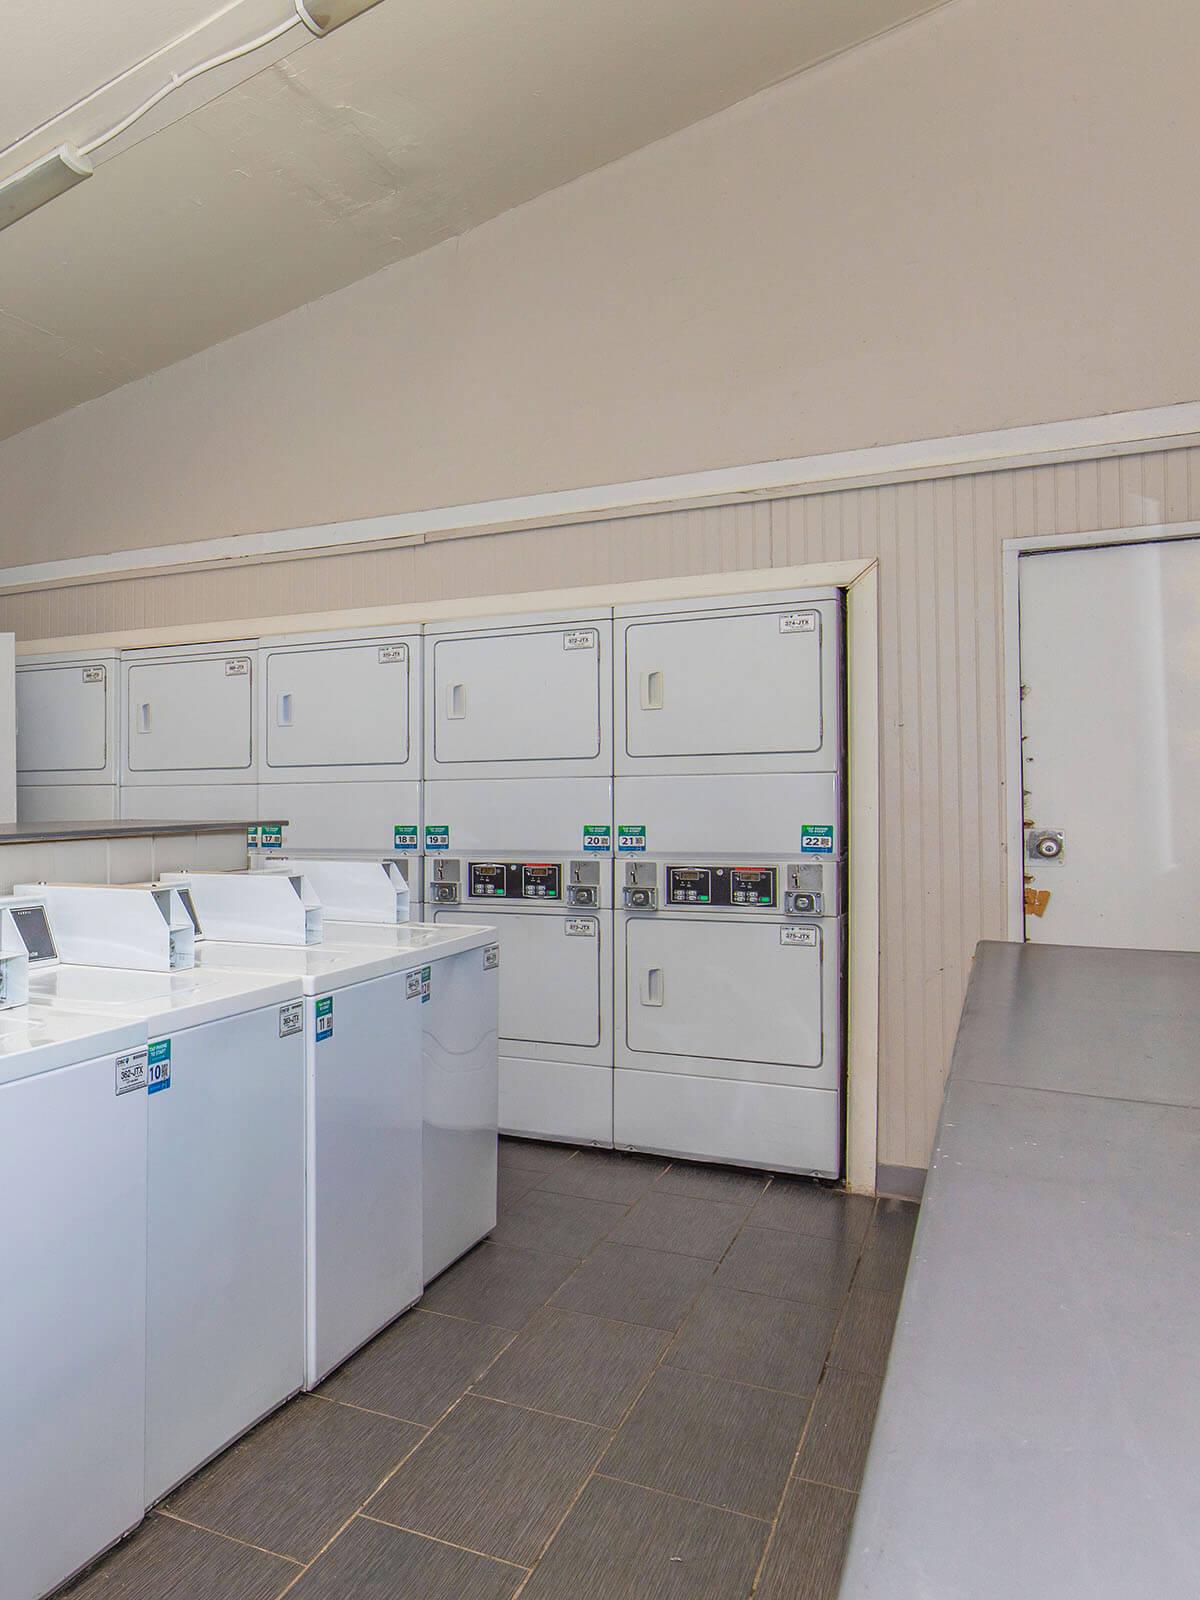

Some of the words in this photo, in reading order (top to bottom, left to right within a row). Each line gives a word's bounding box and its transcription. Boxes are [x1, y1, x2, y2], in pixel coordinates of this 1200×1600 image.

[428, 836, 439, 844] 19
[587, 837, 600, 845] 20
[622, 837, 634, 845] 21
[805, 837, 820, 846] 22
[319, 1018, 325, 1030] 11
[150, 1065, 161, 1081] 10
